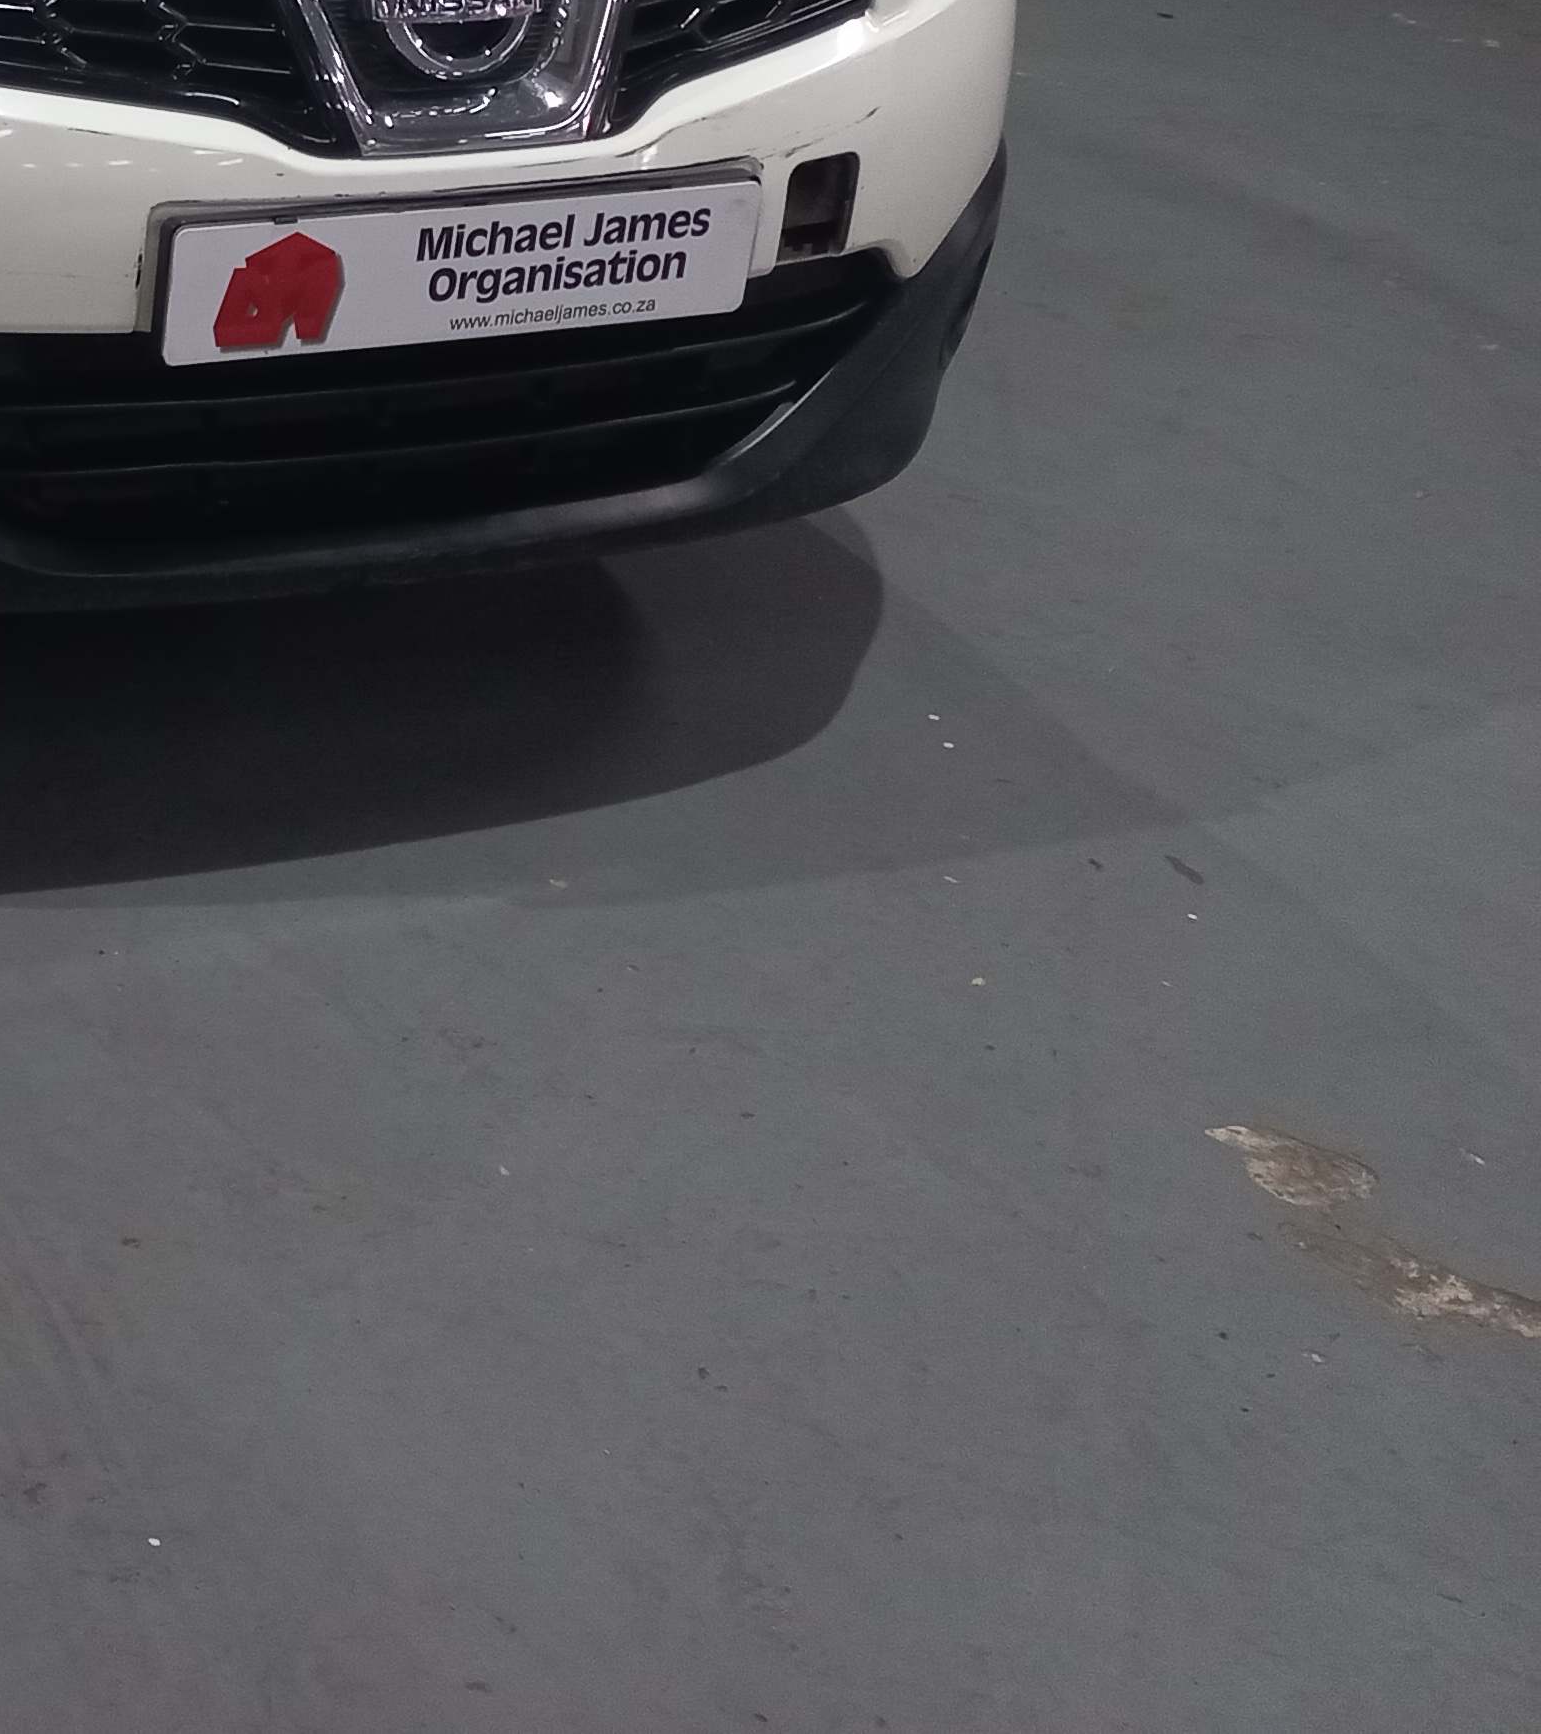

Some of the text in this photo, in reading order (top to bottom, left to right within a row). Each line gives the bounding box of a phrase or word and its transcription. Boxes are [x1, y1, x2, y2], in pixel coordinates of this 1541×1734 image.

[415, 207, 712, 263] Michael James
[427, 249, 687, 304] Organisation
[449, 298, 657, 331] www.michaeljames.co.za
